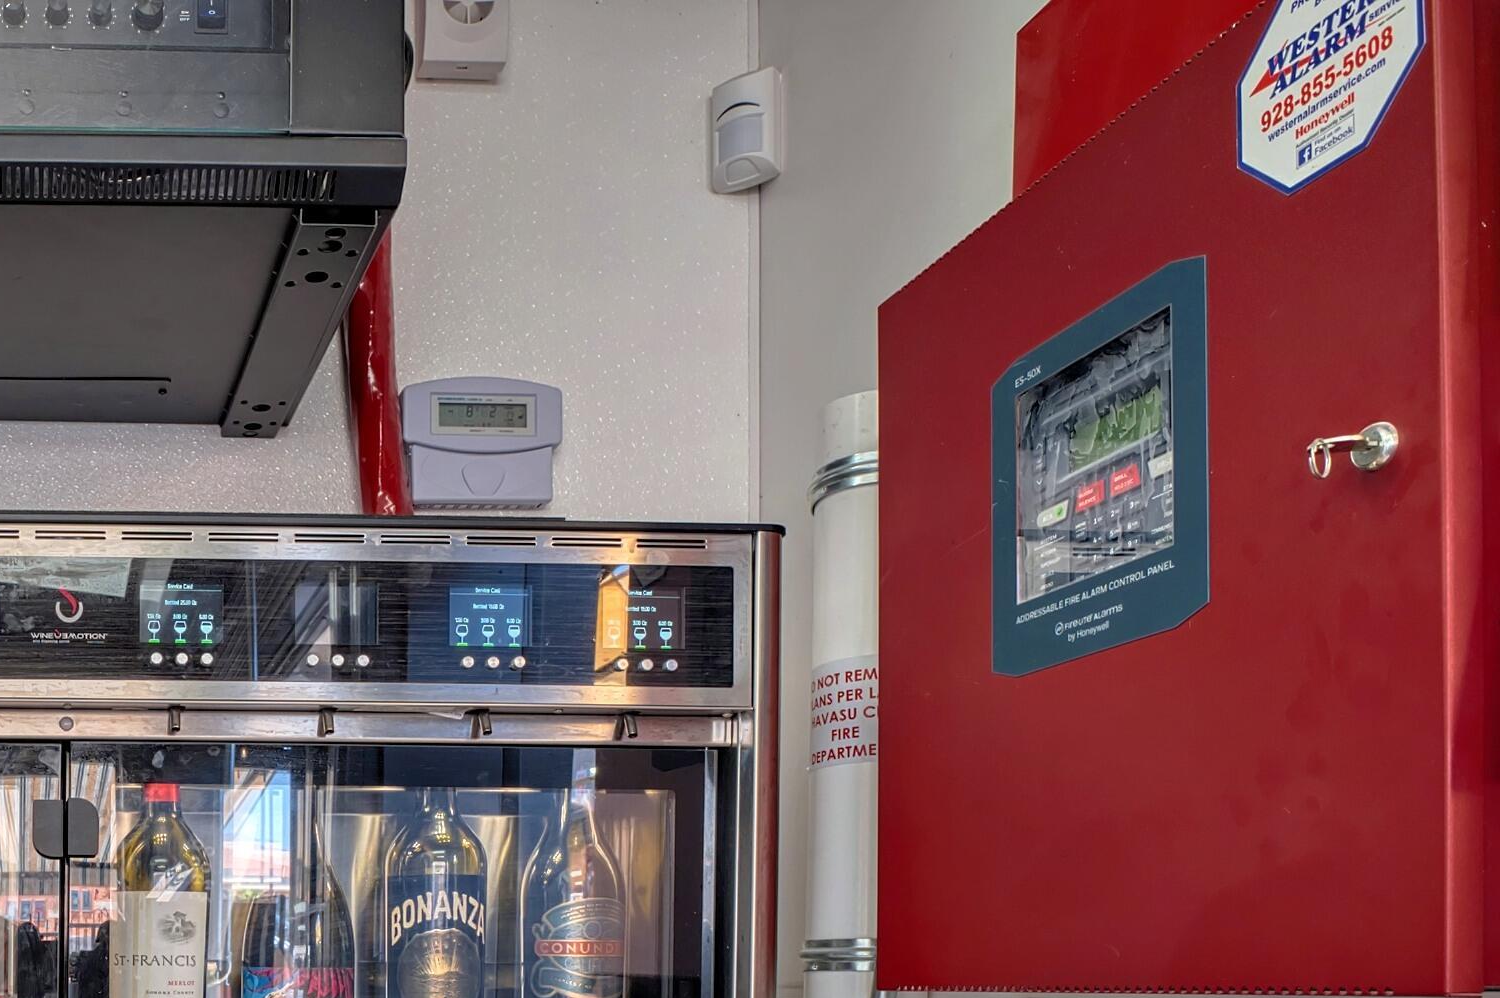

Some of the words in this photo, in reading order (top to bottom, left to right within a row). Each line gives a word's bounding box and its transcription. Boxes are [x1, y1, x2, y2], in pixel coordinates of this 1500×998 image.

[1269, 10, 1369, 99] ALARM
[1261, 25, 1393, 133] 928-855-5608
[1268, 57, 1386, 142] westernalarmservice.com
[1295, 92, 1355, 139] Honeywell
[1315, 126, 1354, 155] Facebook
[1016, 601, 1063, 624] ADDRESSABLE
[1064, 594, 1081, 608] FIRE
[1081, 584, 1107, 601] ALARM
[1109, 570, 1145, 592] CONTROL
[1147, 559, 1175, 579] PANEL
[1067, 632, 1076, 642] by
[1076, 620, 1110, 639] Honeywell
[817, 673, 840, 690] NOT
[845, 667, 878, 683] REM
[838, 688, 863, 703] PER
[831, 726, 860, 741] FIRE
[812, 743, 877, 765] DEPARTME
[390, 890, 485, 946] BONANZA
[132, 954, 197, 967] FRANCIS
[540, 942, 615, 954] CONUND
